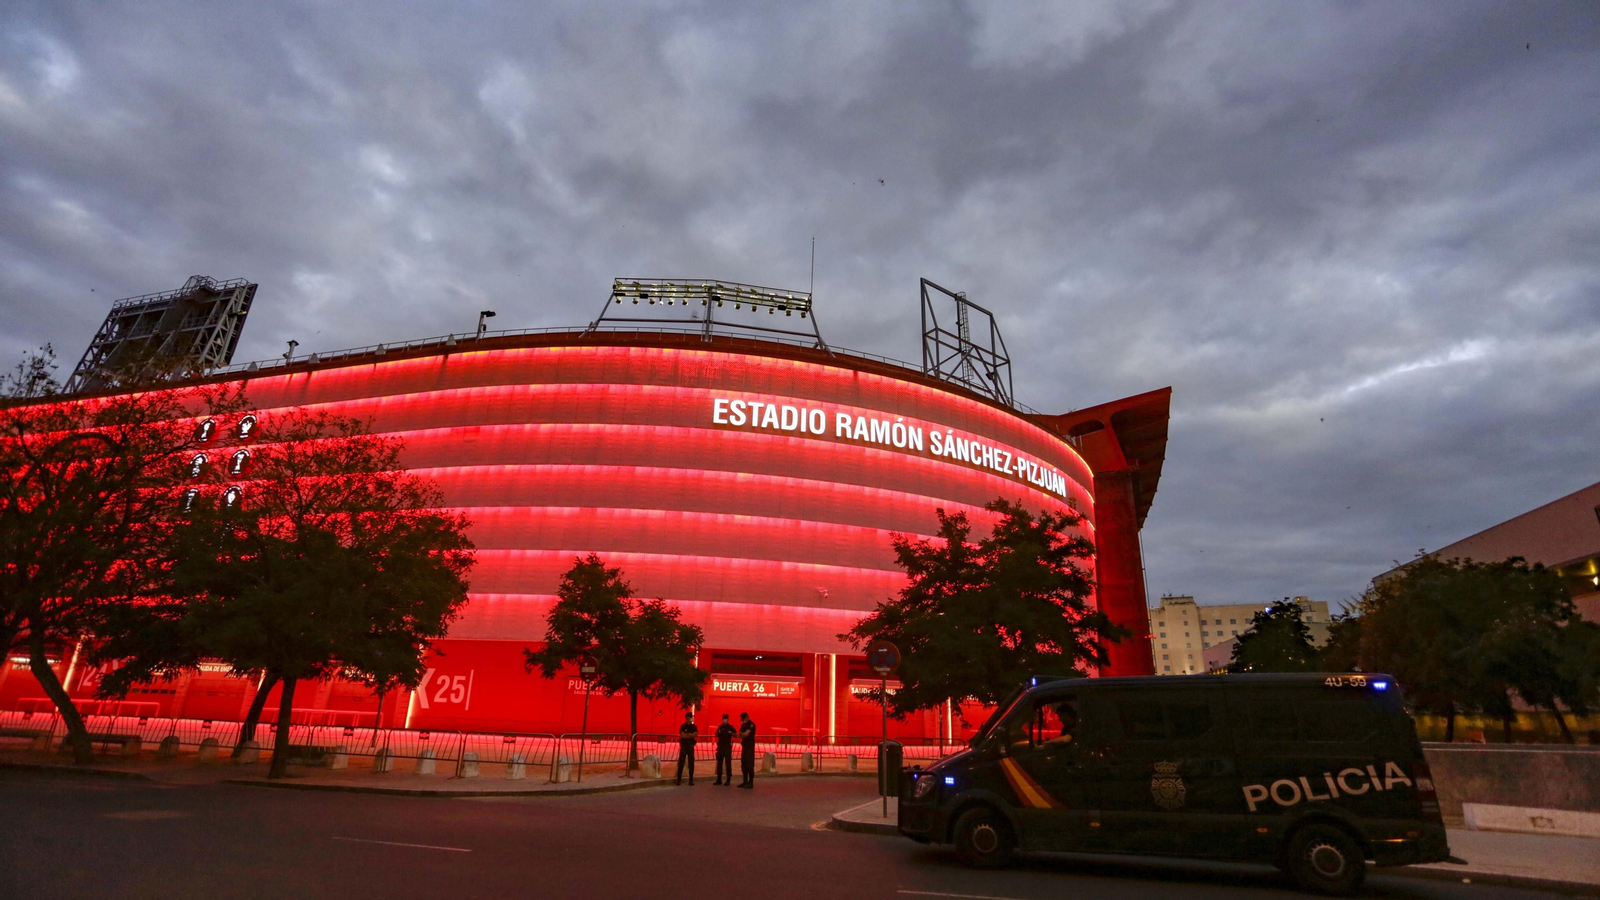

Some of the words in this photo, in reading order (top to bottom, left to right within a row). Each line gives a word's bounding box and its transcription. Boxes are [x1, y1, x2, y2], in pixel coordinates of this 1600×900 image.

[713, 398, 826, 435] ESTADIO
[835, 412, 923, 451] RAMÓN
[930, 429, 1066, 498] SÁNCHEZ-PIZJUÁN
[433, 675, 467, 704] 25
[713, 681, 750, 692] PUERTA
[753, 683, 765, 693] 26
[1324, 677, 1367, 687] 4U-59
[1242, 761, 1413, 812] POLICIA
